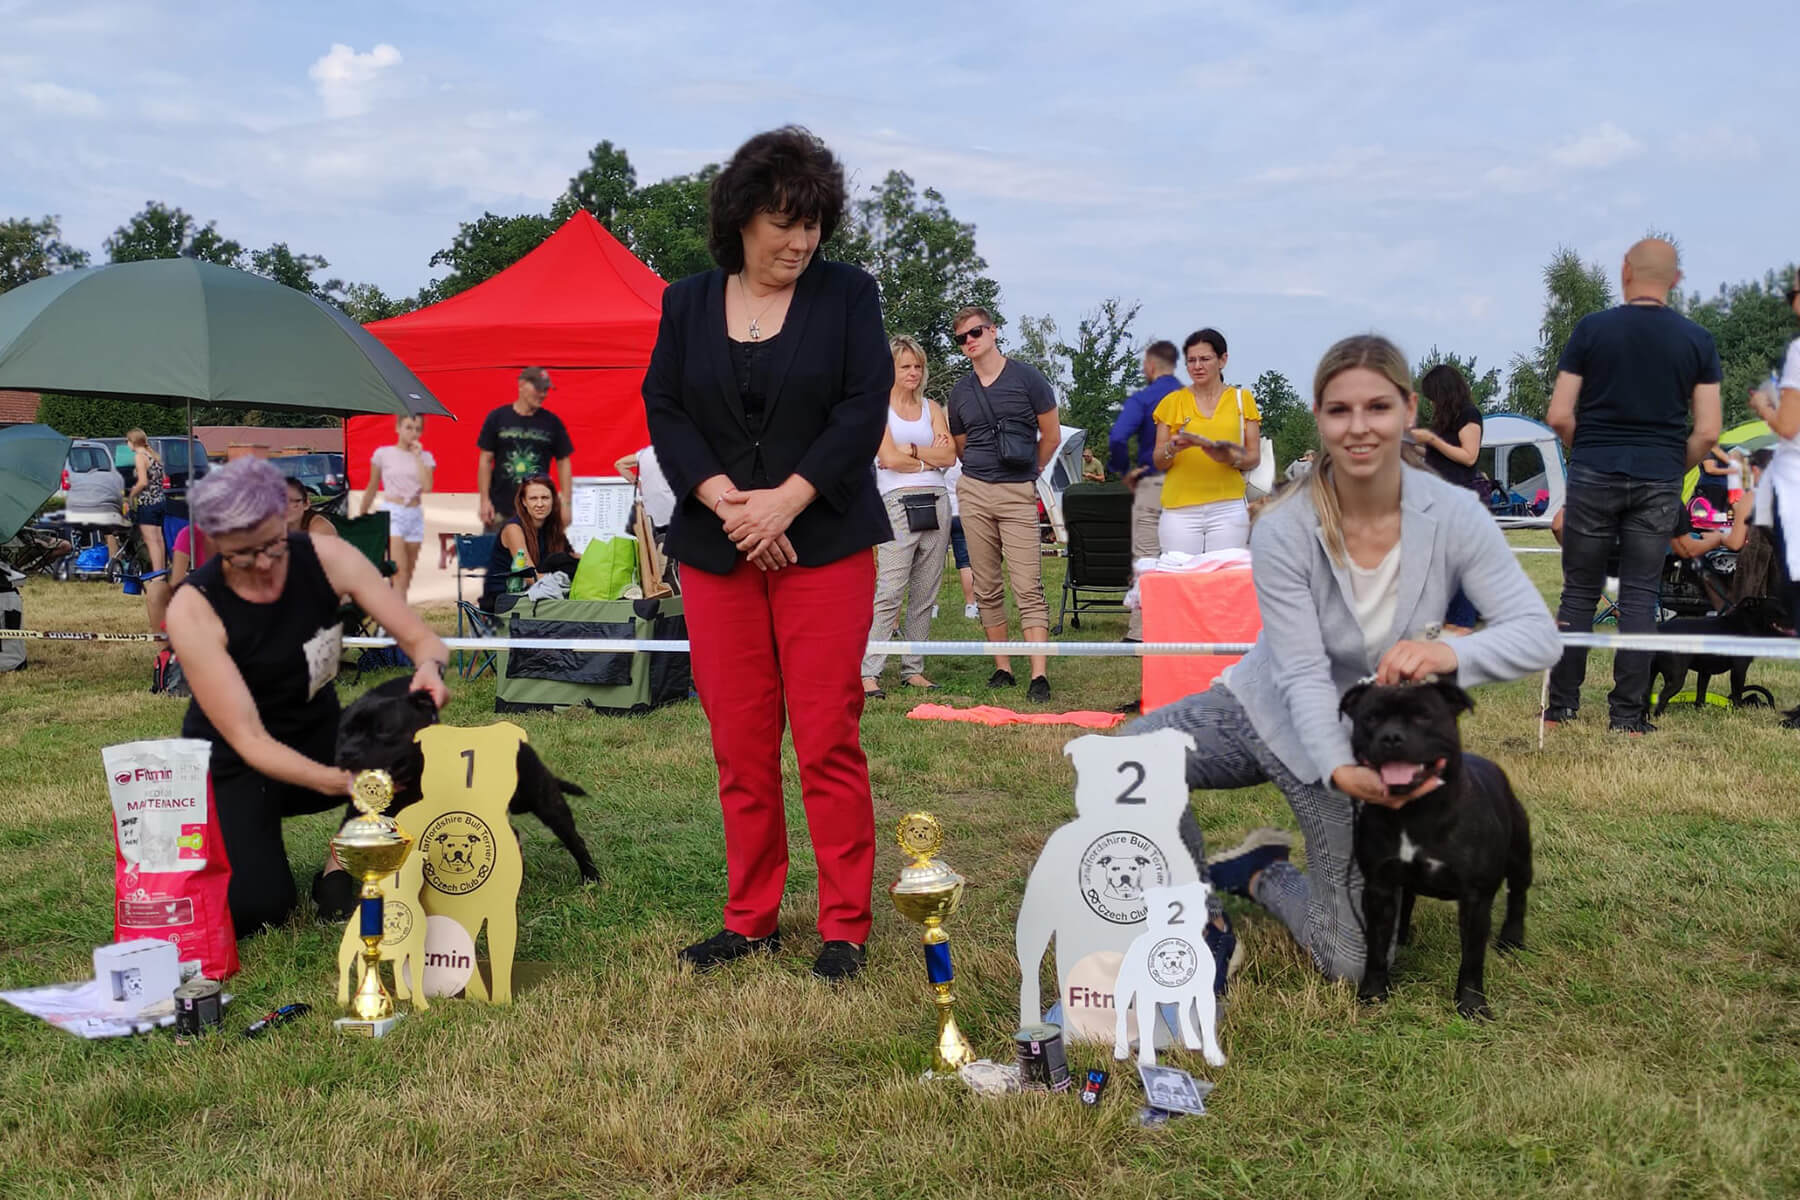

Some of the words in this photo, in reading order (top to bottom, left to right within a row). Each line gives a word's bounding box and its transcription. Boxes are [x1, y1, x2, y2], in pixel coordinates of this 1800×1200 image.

[135, 767, 173, 782] Fitmin
[460, 749, 475, 788] 1
[1115, 760, 1147, 804] 2
[465, 816, 482, 831] Bull
[480, 828, 492, 861] Terrier
[1130, 836, 1151, 852] Bull
[433, 876, 458, 892] Czech
[459, 878, 479, 892] Club
[1098, 904, 1128, 921] Czech
[1168, 901, 1185, 925] 2
